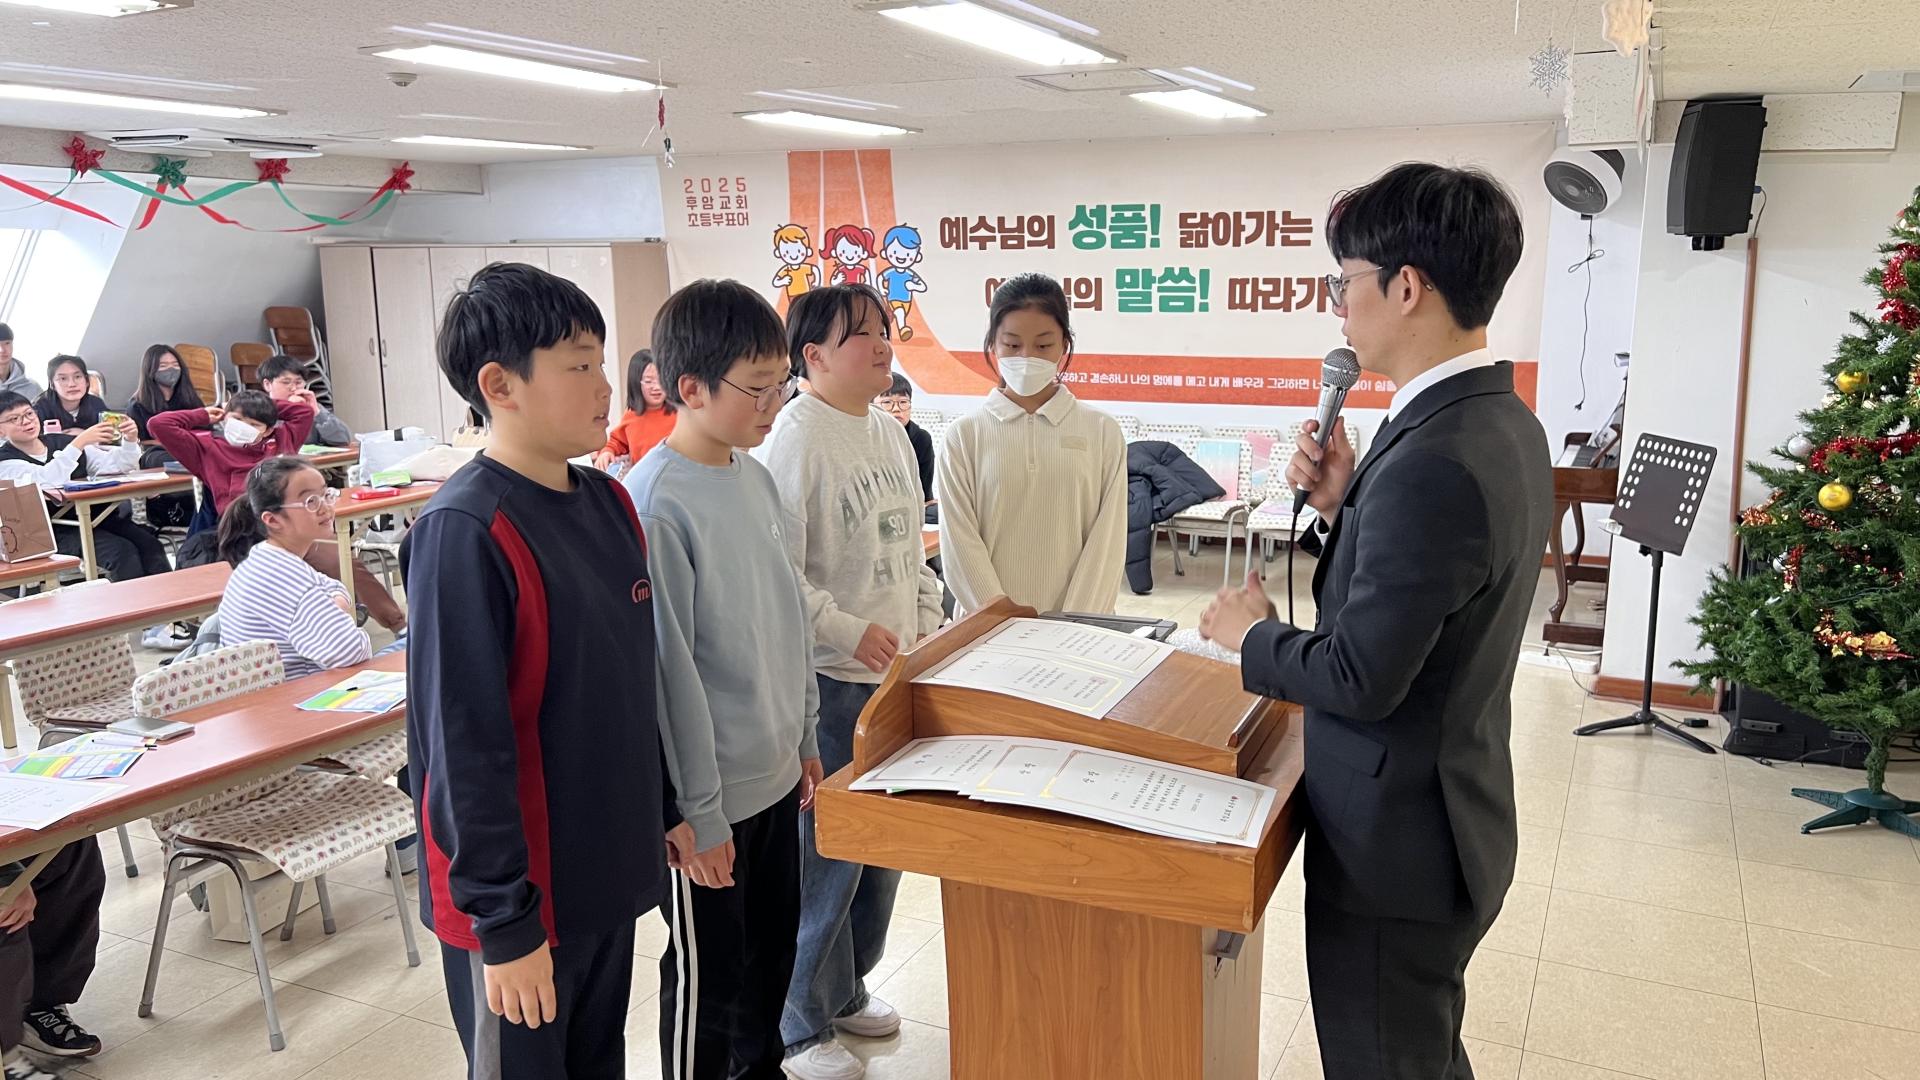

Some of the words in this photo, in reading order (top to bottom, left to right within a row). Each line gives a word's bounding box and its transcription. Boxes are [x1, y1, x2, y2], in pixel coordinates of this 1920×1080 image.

[684, 177, 746, 194] 2025
[686, 195, 748, 210] 후암교회
[688, 212, 749, 227] 초등부표어
[940, 215, 1056, 250] 예수님의
[1068, 203, 1161, 250] 성품!
[1178, 210, 1313, 249] 닮아가는
[1115, 266, 1211, 313] 말씀!
[1228, 276, 1330, 313] 따라가
[1090, 373, 1128, 385] 겸손하니
[1130, 374, 1150, 385] 나의
[1153, 375, 1183, 387] 멍에를
[1185, 376, 1206, 388] 메고
[1209, 377, 1230, 388] 내게
[1232, 377, 1264, 389] 배우라
[1267, 378, 1310, 390] 그리하면
